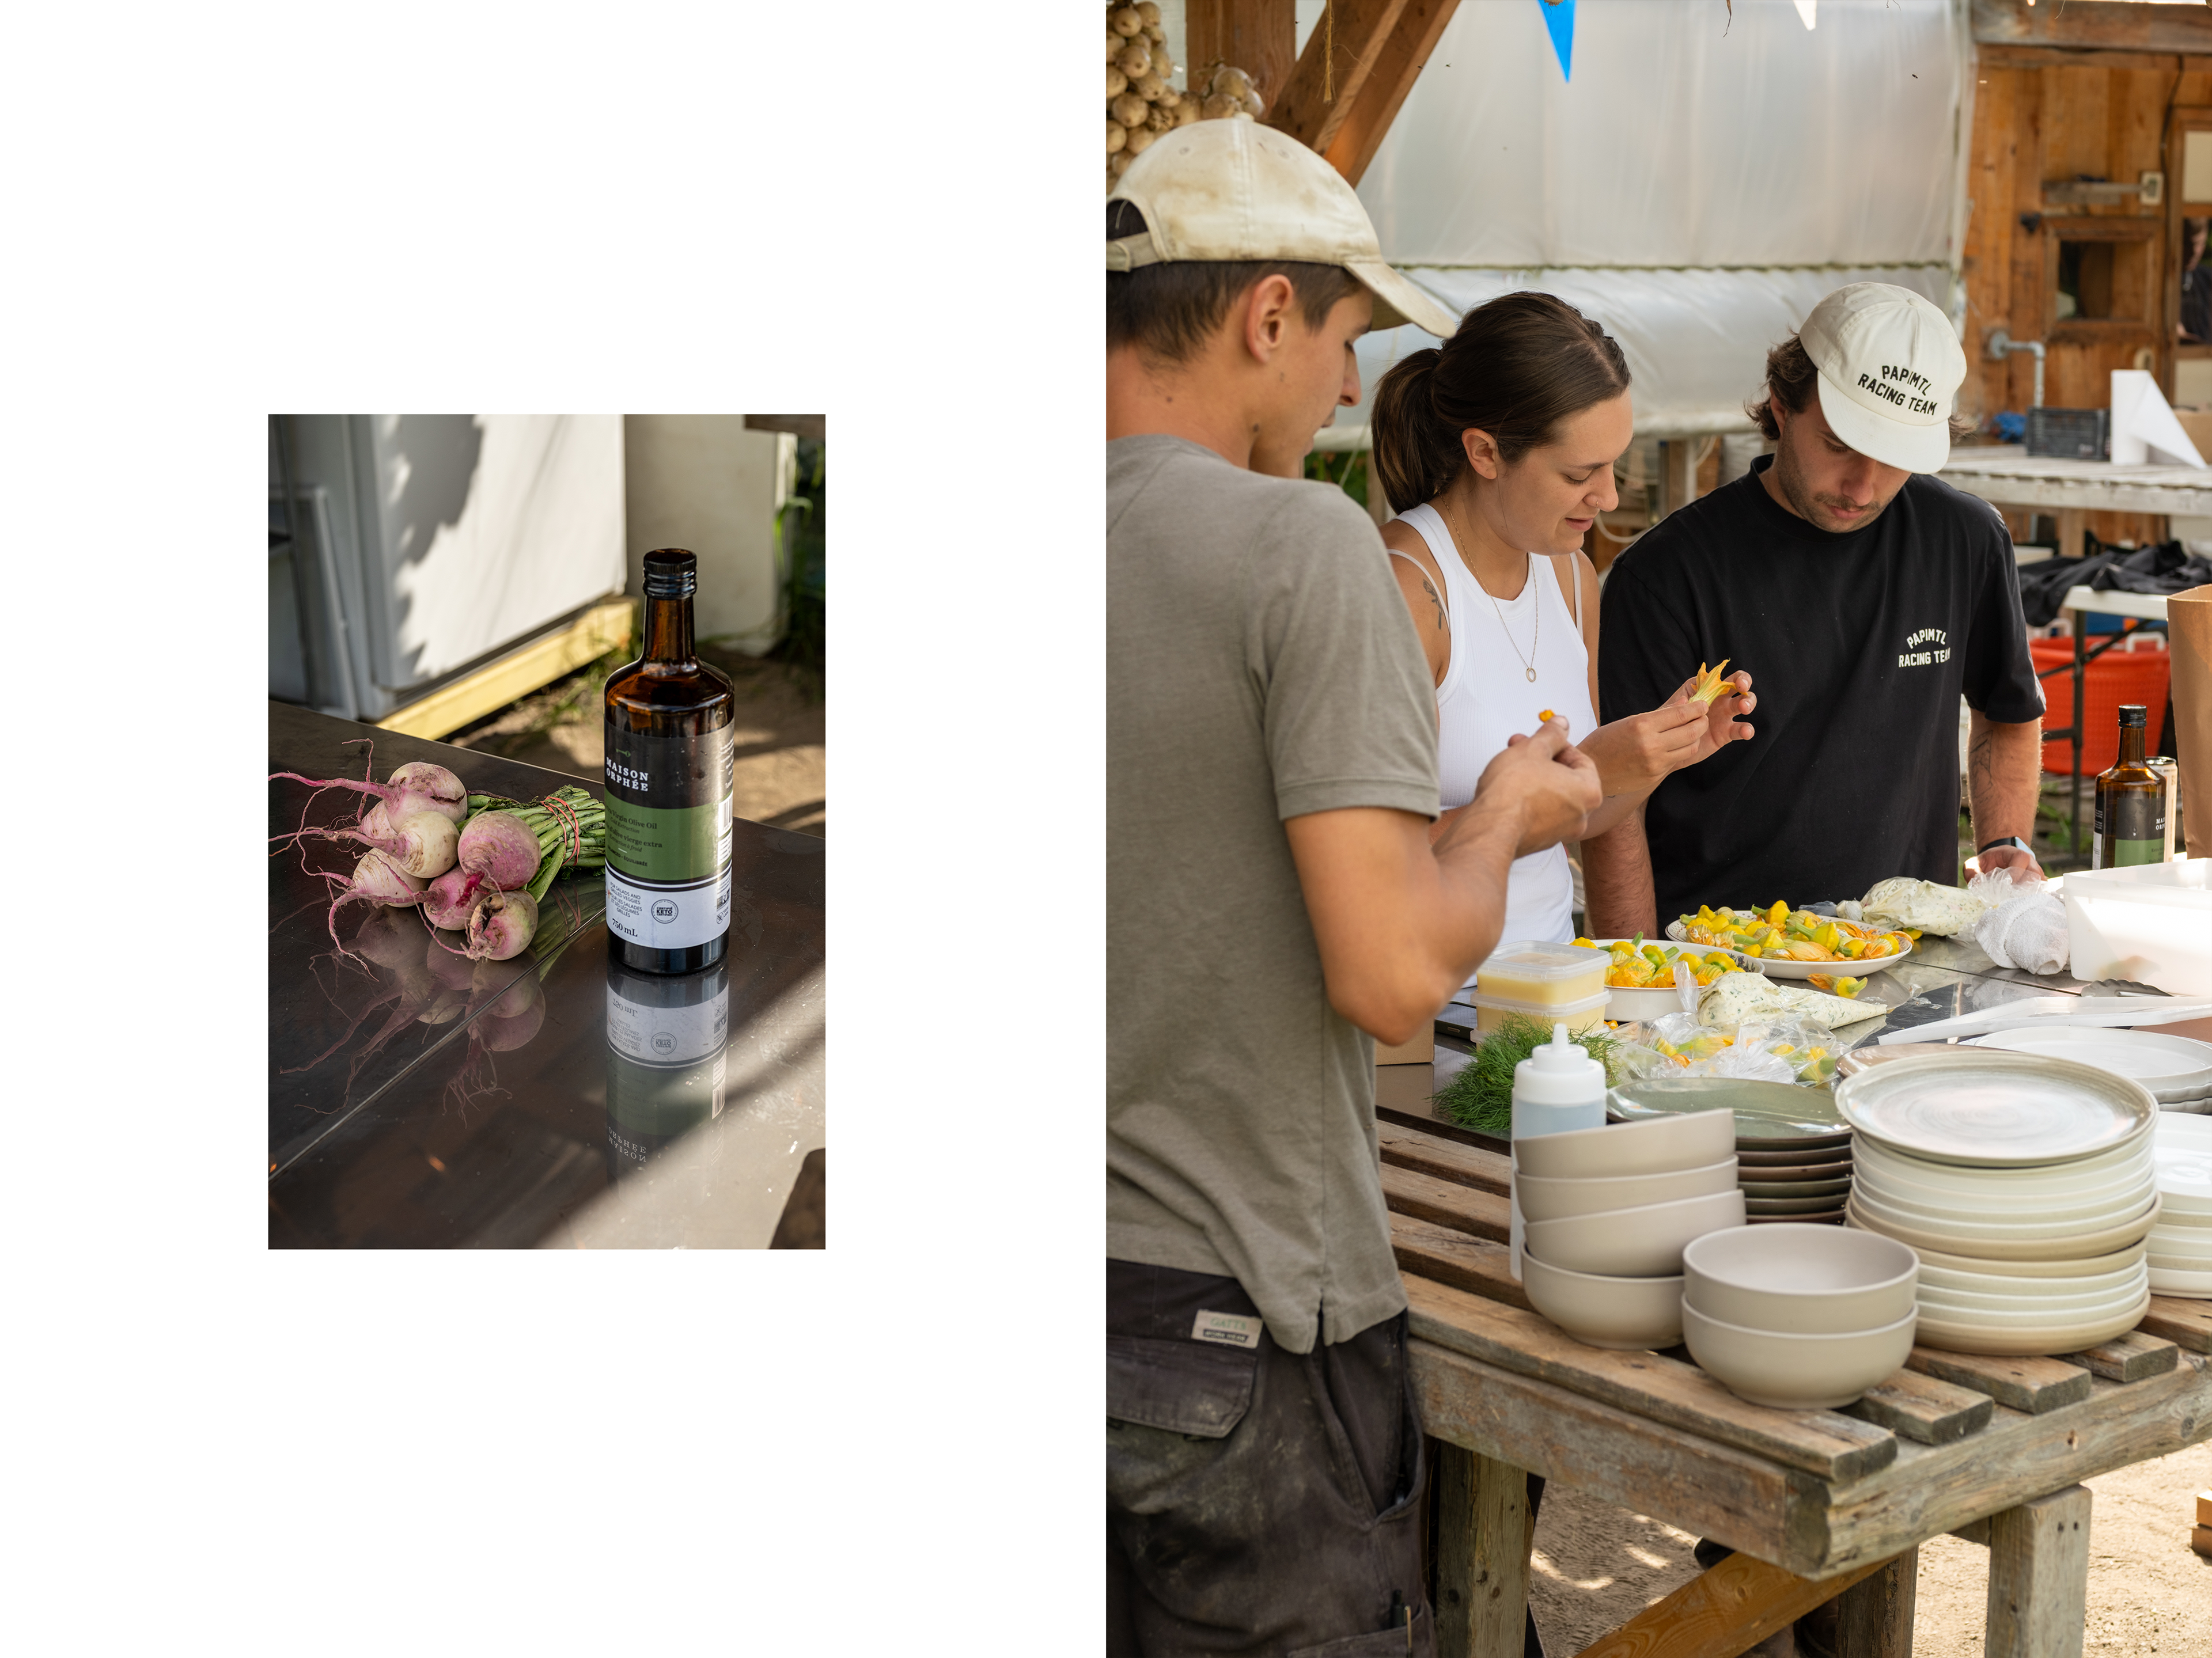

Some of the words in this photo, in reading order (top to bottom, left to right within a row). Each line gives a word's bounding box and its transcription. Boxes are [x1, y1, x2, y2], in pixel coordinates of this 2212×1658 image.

[1857, 373, 1906, 406] RACING
[1908, 397, 1938, 416] TEAM
[1907, 628, 1946, 649] PAPIMTL
[1899, 651, 1931, 668] RACING
[606, 757, 649, 781] MAISON
[606, 767, 649, 792] ORPHÉE
[612, 810, 627, 822] Virgin
[628, 818, 645, 828] Olive
[624, 835, 642, 845] vierge
[611, 887, 622, 898] GRILLED
[623, 894, 641, 905] VEGGIES
[616, 886, 630, 897] SALADS
[623, 901, 642, 912] SALADES
[612, 918, 623, 931] 750
[624, 928, 638, 938] mL
